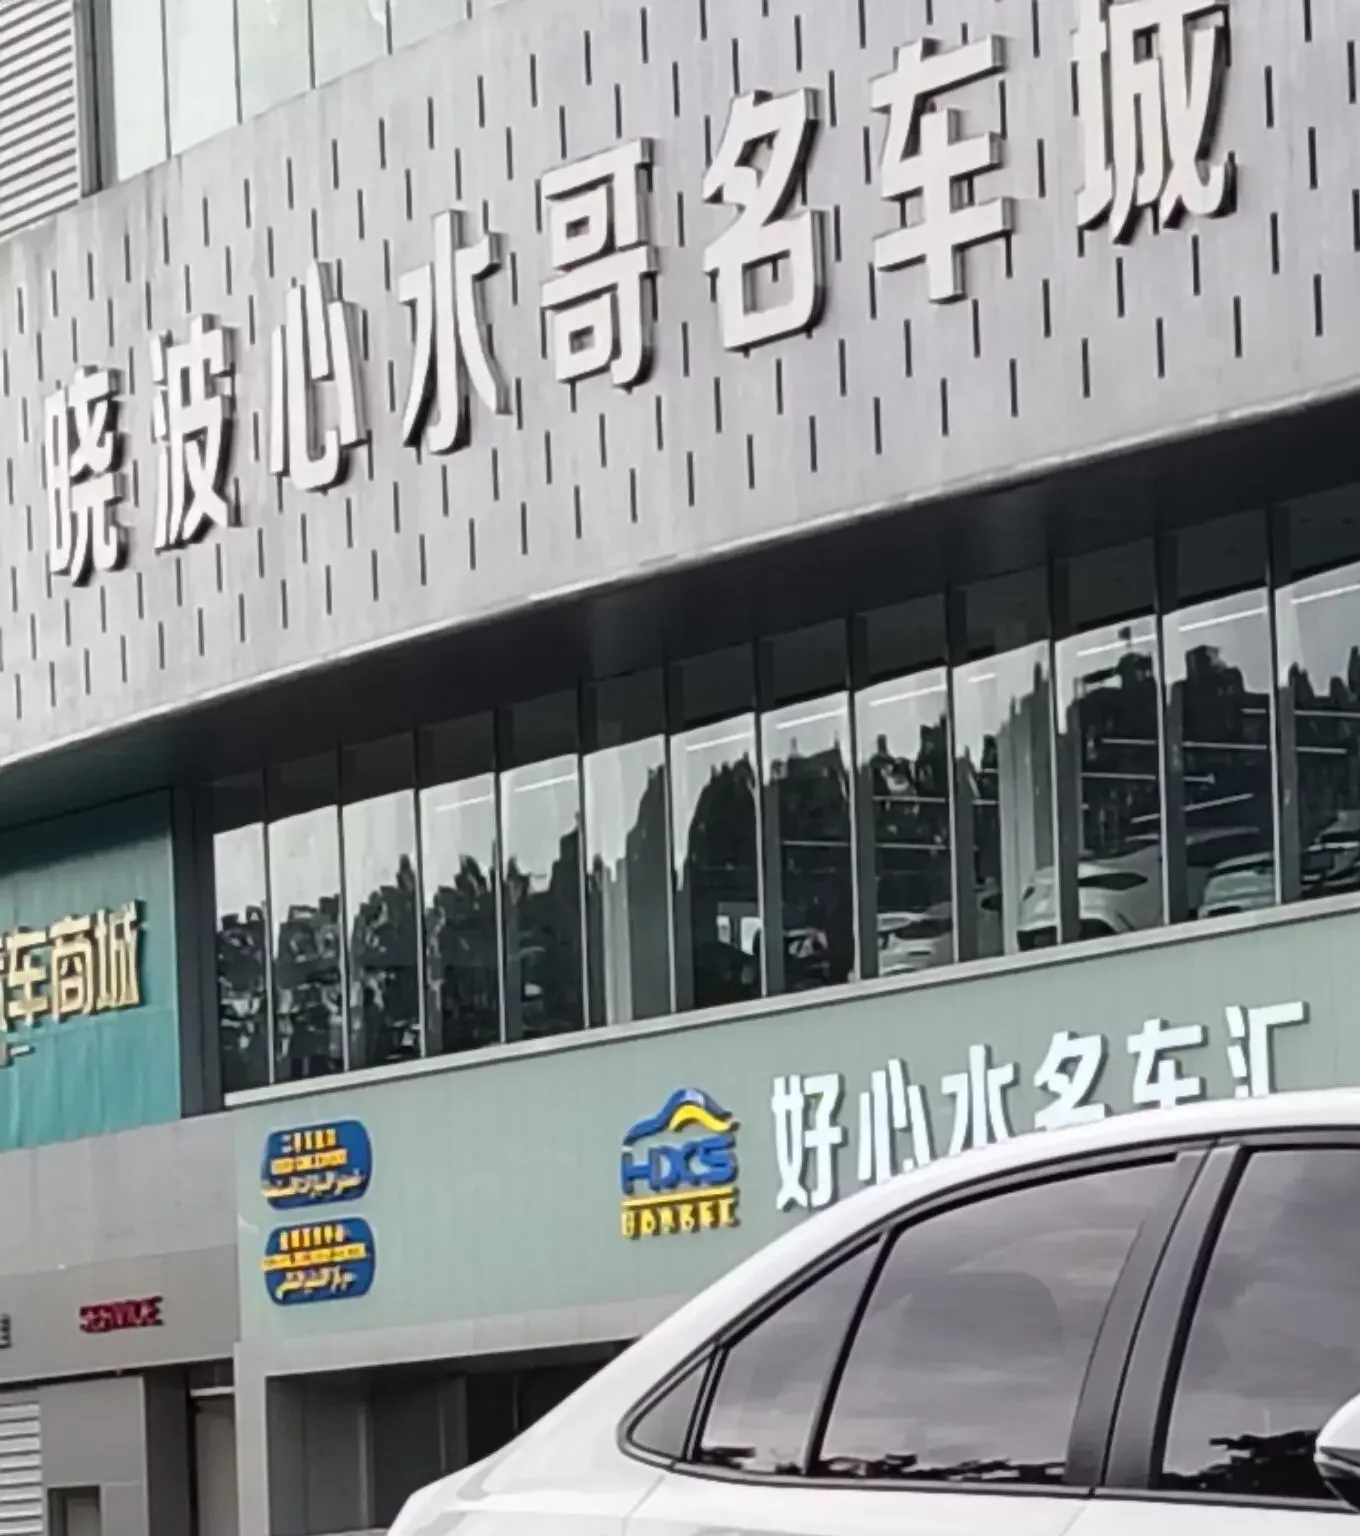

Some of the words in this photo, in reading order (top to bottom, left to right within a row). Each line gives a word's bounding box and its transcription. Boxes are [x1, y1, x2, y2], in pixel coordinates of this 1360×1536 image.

[42, 0, 1236, 586] 晓波心水哥名车城
[0, 899, 146, 1033] 车商城
[771, 1001, 1309, 1212] 好心水名车汇
